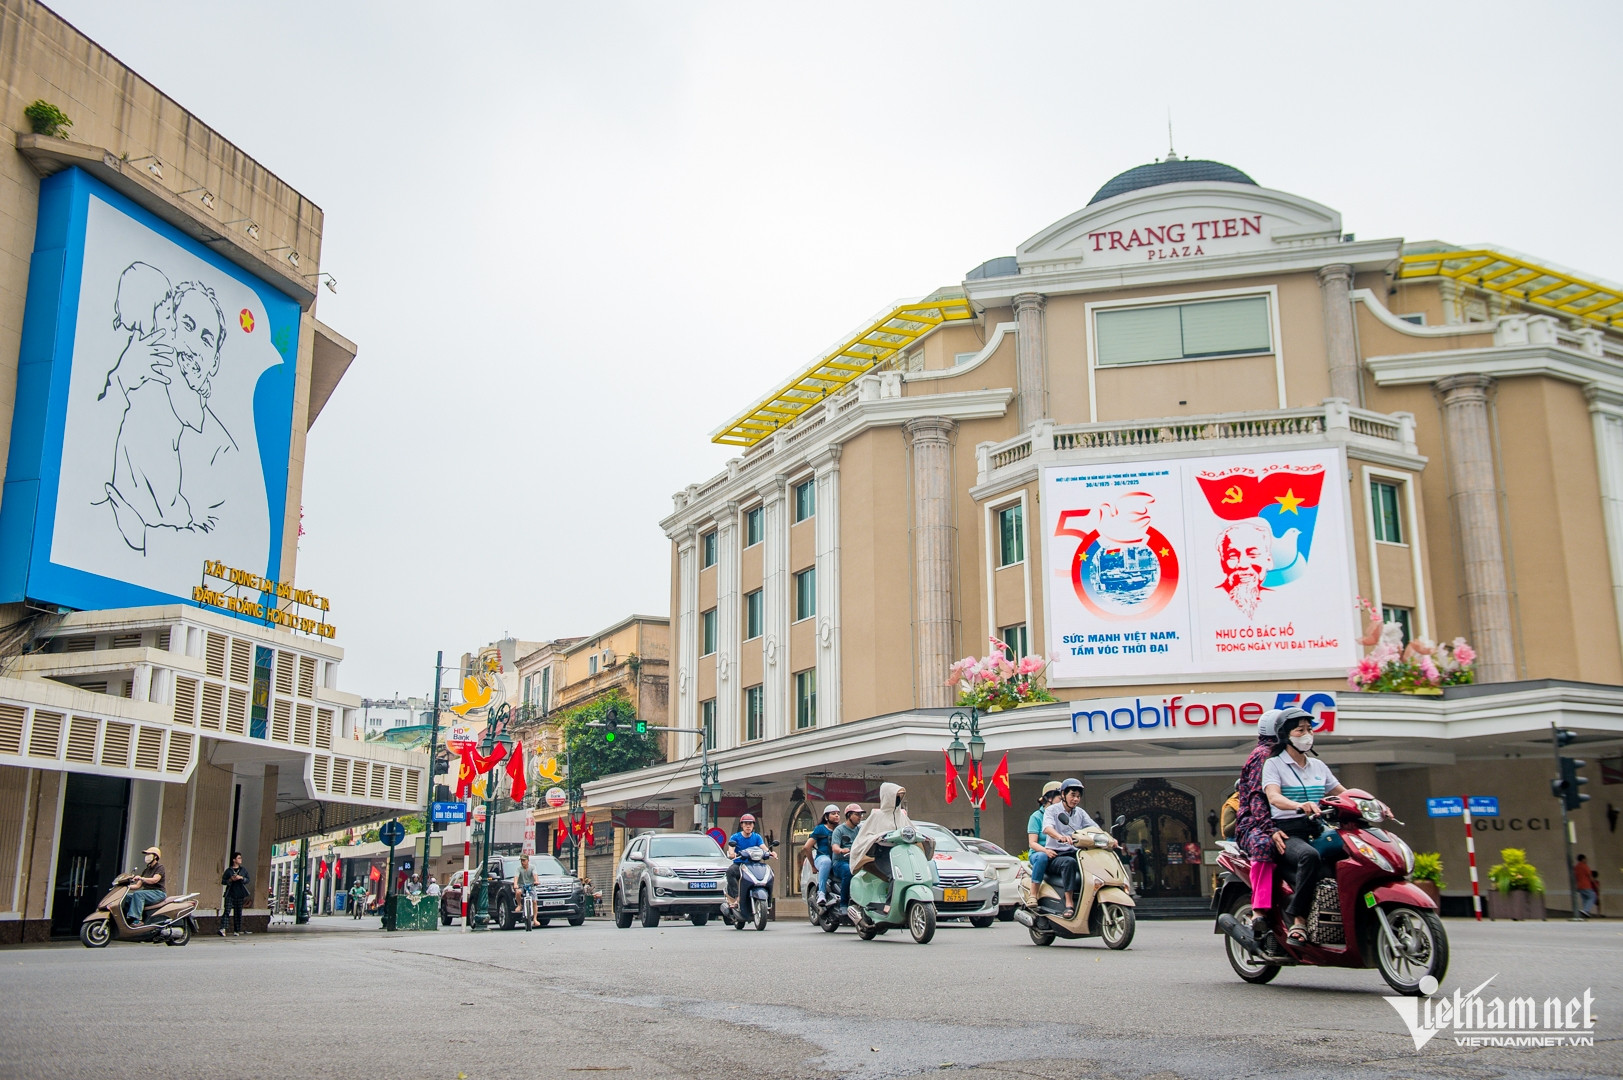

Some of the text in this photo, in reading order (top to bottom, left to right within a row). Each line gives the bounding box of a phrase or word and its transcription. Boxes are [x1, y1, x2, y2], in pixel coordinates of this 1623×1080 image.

[1088, 215, 1263, 252] TRANG TIEN
[1148, 245, 1205, 260] PLAZA
[1200, 466, 1255, 478] 30.4.1975
[1062, 632, 1085, 645] SỨC
[1087, 632, 1121, 644] MẠNH
[1123, 630, 1147, 643] VIỆT
[1215, 628, 1237, 639] NHƯ
[1239, 625, 1254, 638] CÓ
[1256, 624, 1277, 637] BÁC
[1097, 644, 1119, 655] VÓC
[1121, 642, 1147, 654] THỜI
[1149, 643, 1169, 655] ĐẠI
[1215, 643, 1246, 653] TRONG
[1247, 639, 1272, 651] NGÀY
[1274, 641, 1289, 650] VUI
[1290, 640, 1306, 651] ĐẠI
[1071, 695, 1264, 733] mobifone
[636, 721, 646, 733] 16
[453, 733, 470, 741] Bank
[1474, 818, 1551, 832] GUCCI
